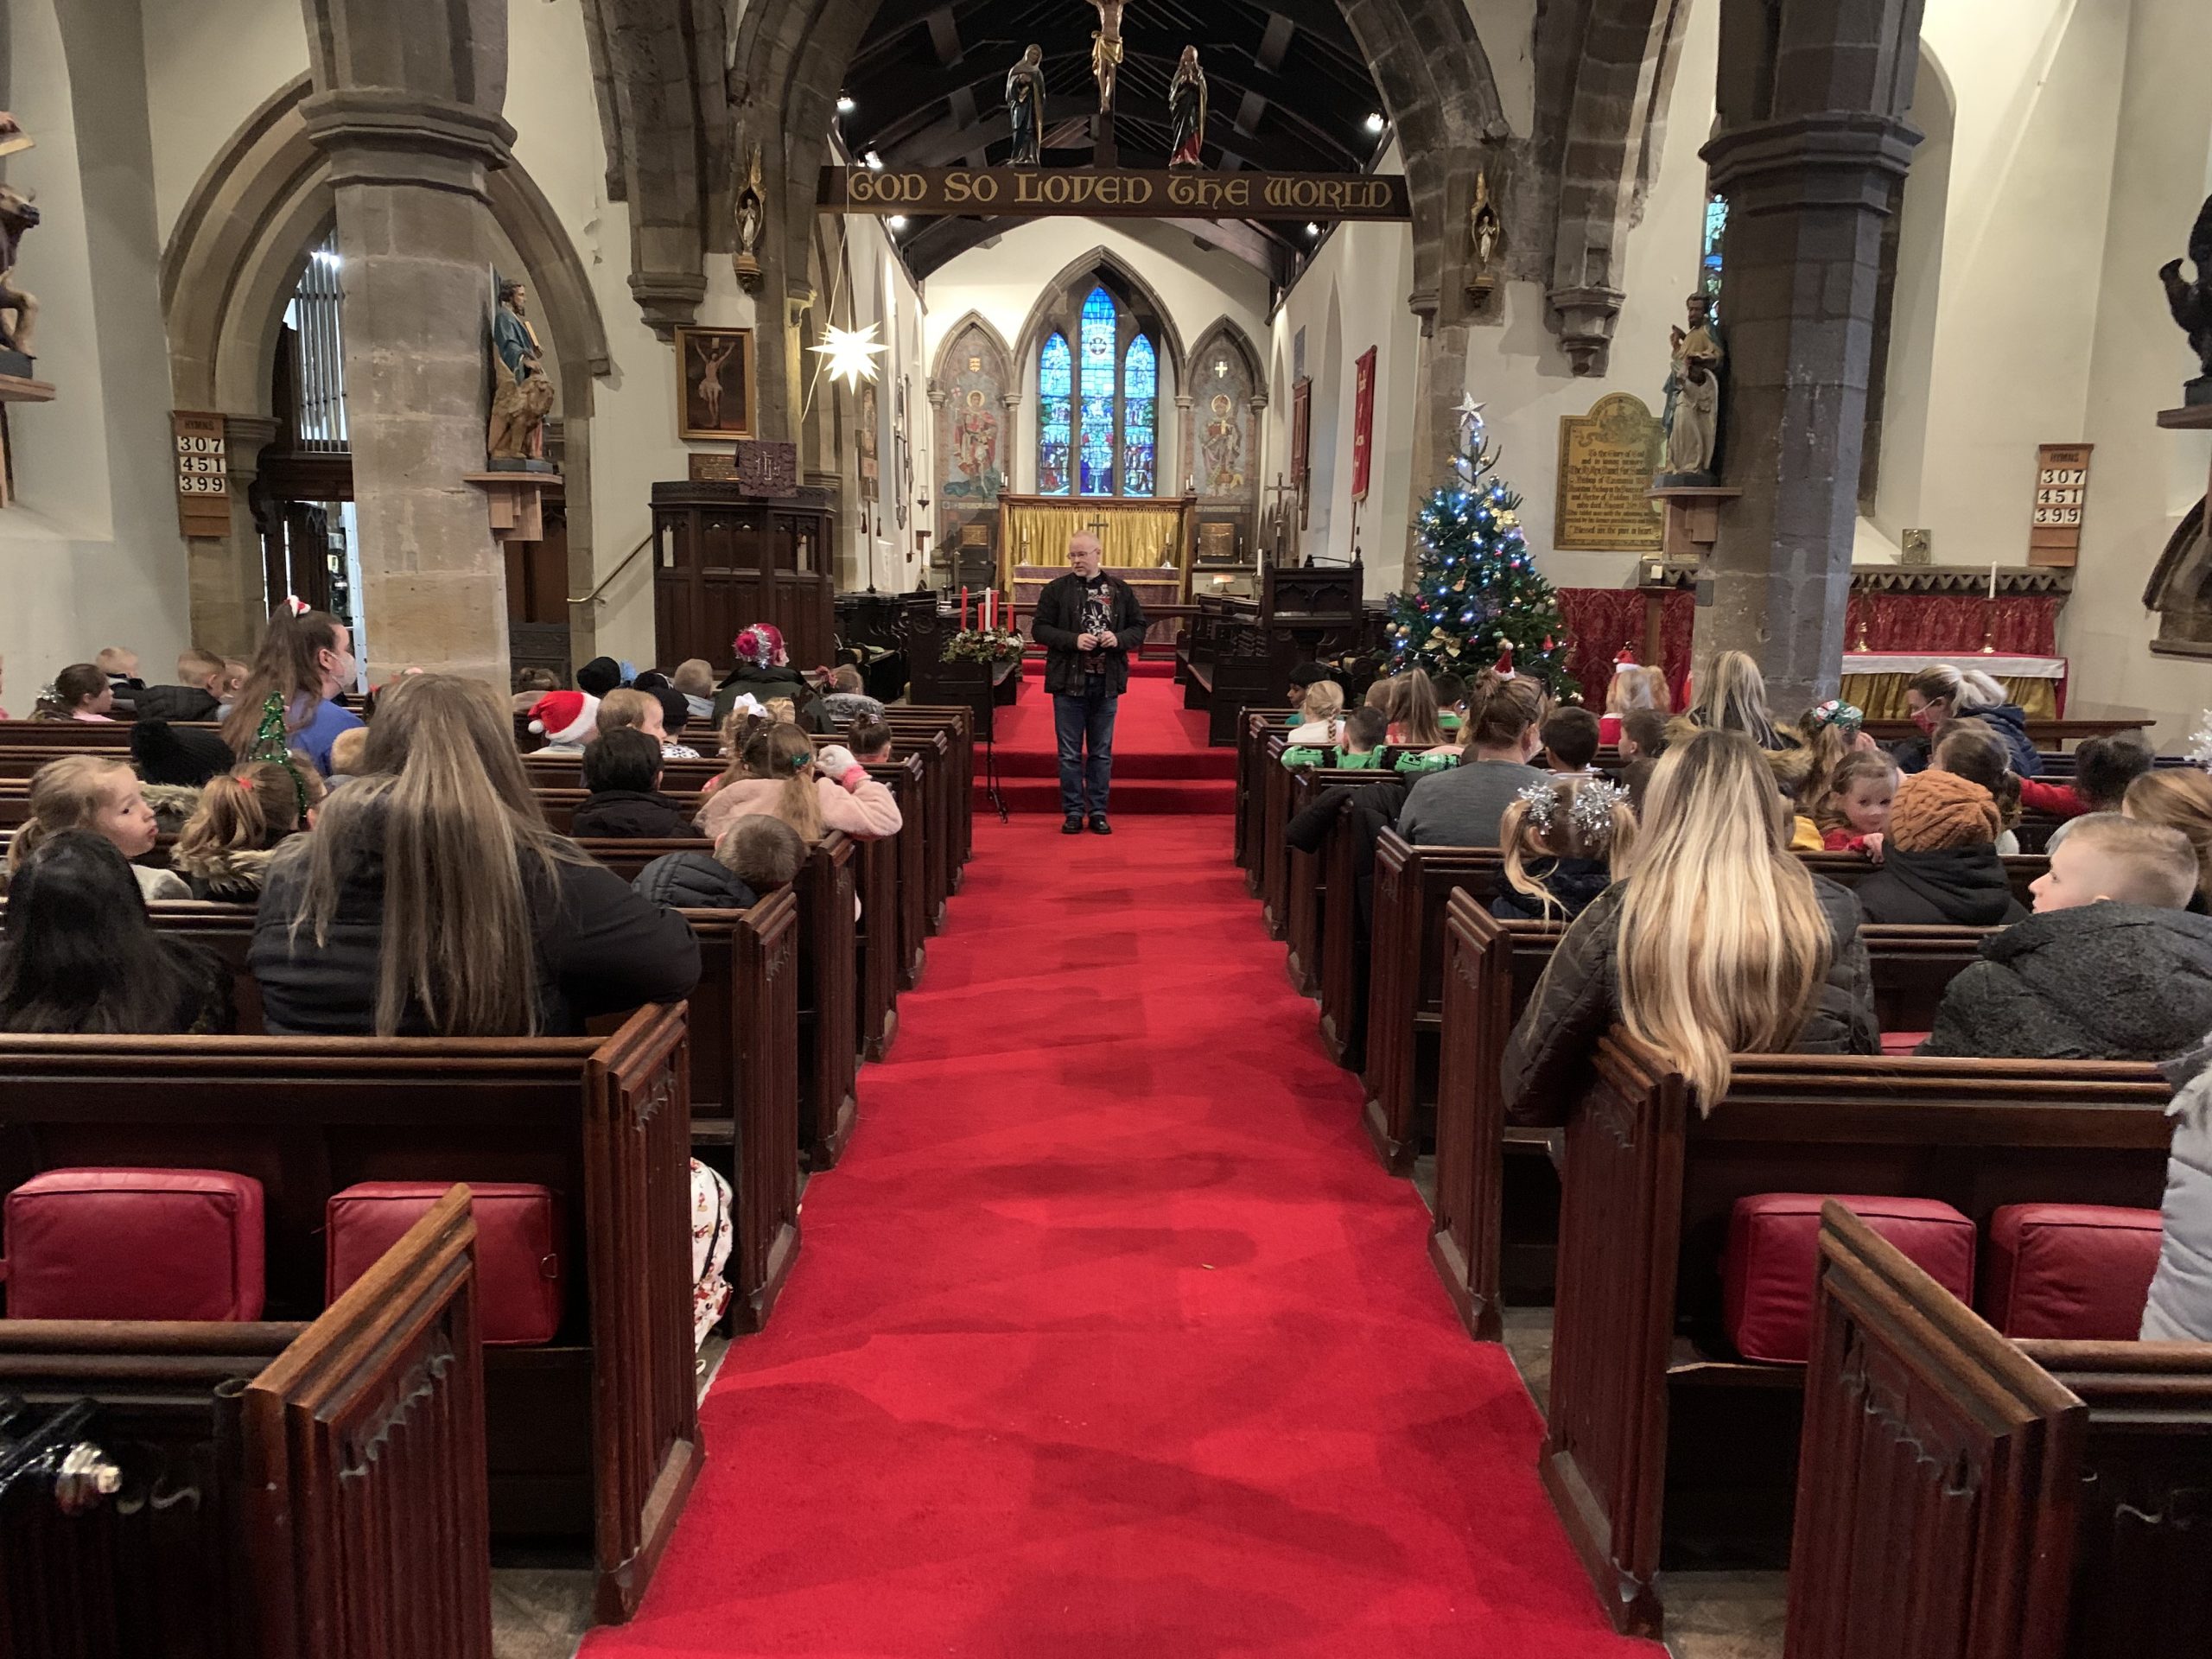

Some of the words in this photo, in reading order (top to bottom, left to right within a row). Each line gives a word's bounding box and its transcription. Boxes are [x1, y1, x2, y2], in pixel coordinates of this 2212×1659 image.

[849, 172, 928, 202] GOD
[944, 172, 999, 202] SO
[1014, 172, 1154, 205] LOVED
[1167, 175, 1250, 207] THE
[1263, 176, 1393, 212] WORLD
[185, 421, 215, 430] HYMNS
[181, 436, 221, 453] 307
[182, 457, 221, 473] 451
[2050, 453, 2079, 462] HYMNS
[181, 476, 223, 492] 399
[2043, 469, 2083, 484] 307
[2039, 489, 2078, 503] 451
[2036, 508, 2079, 523] 399
